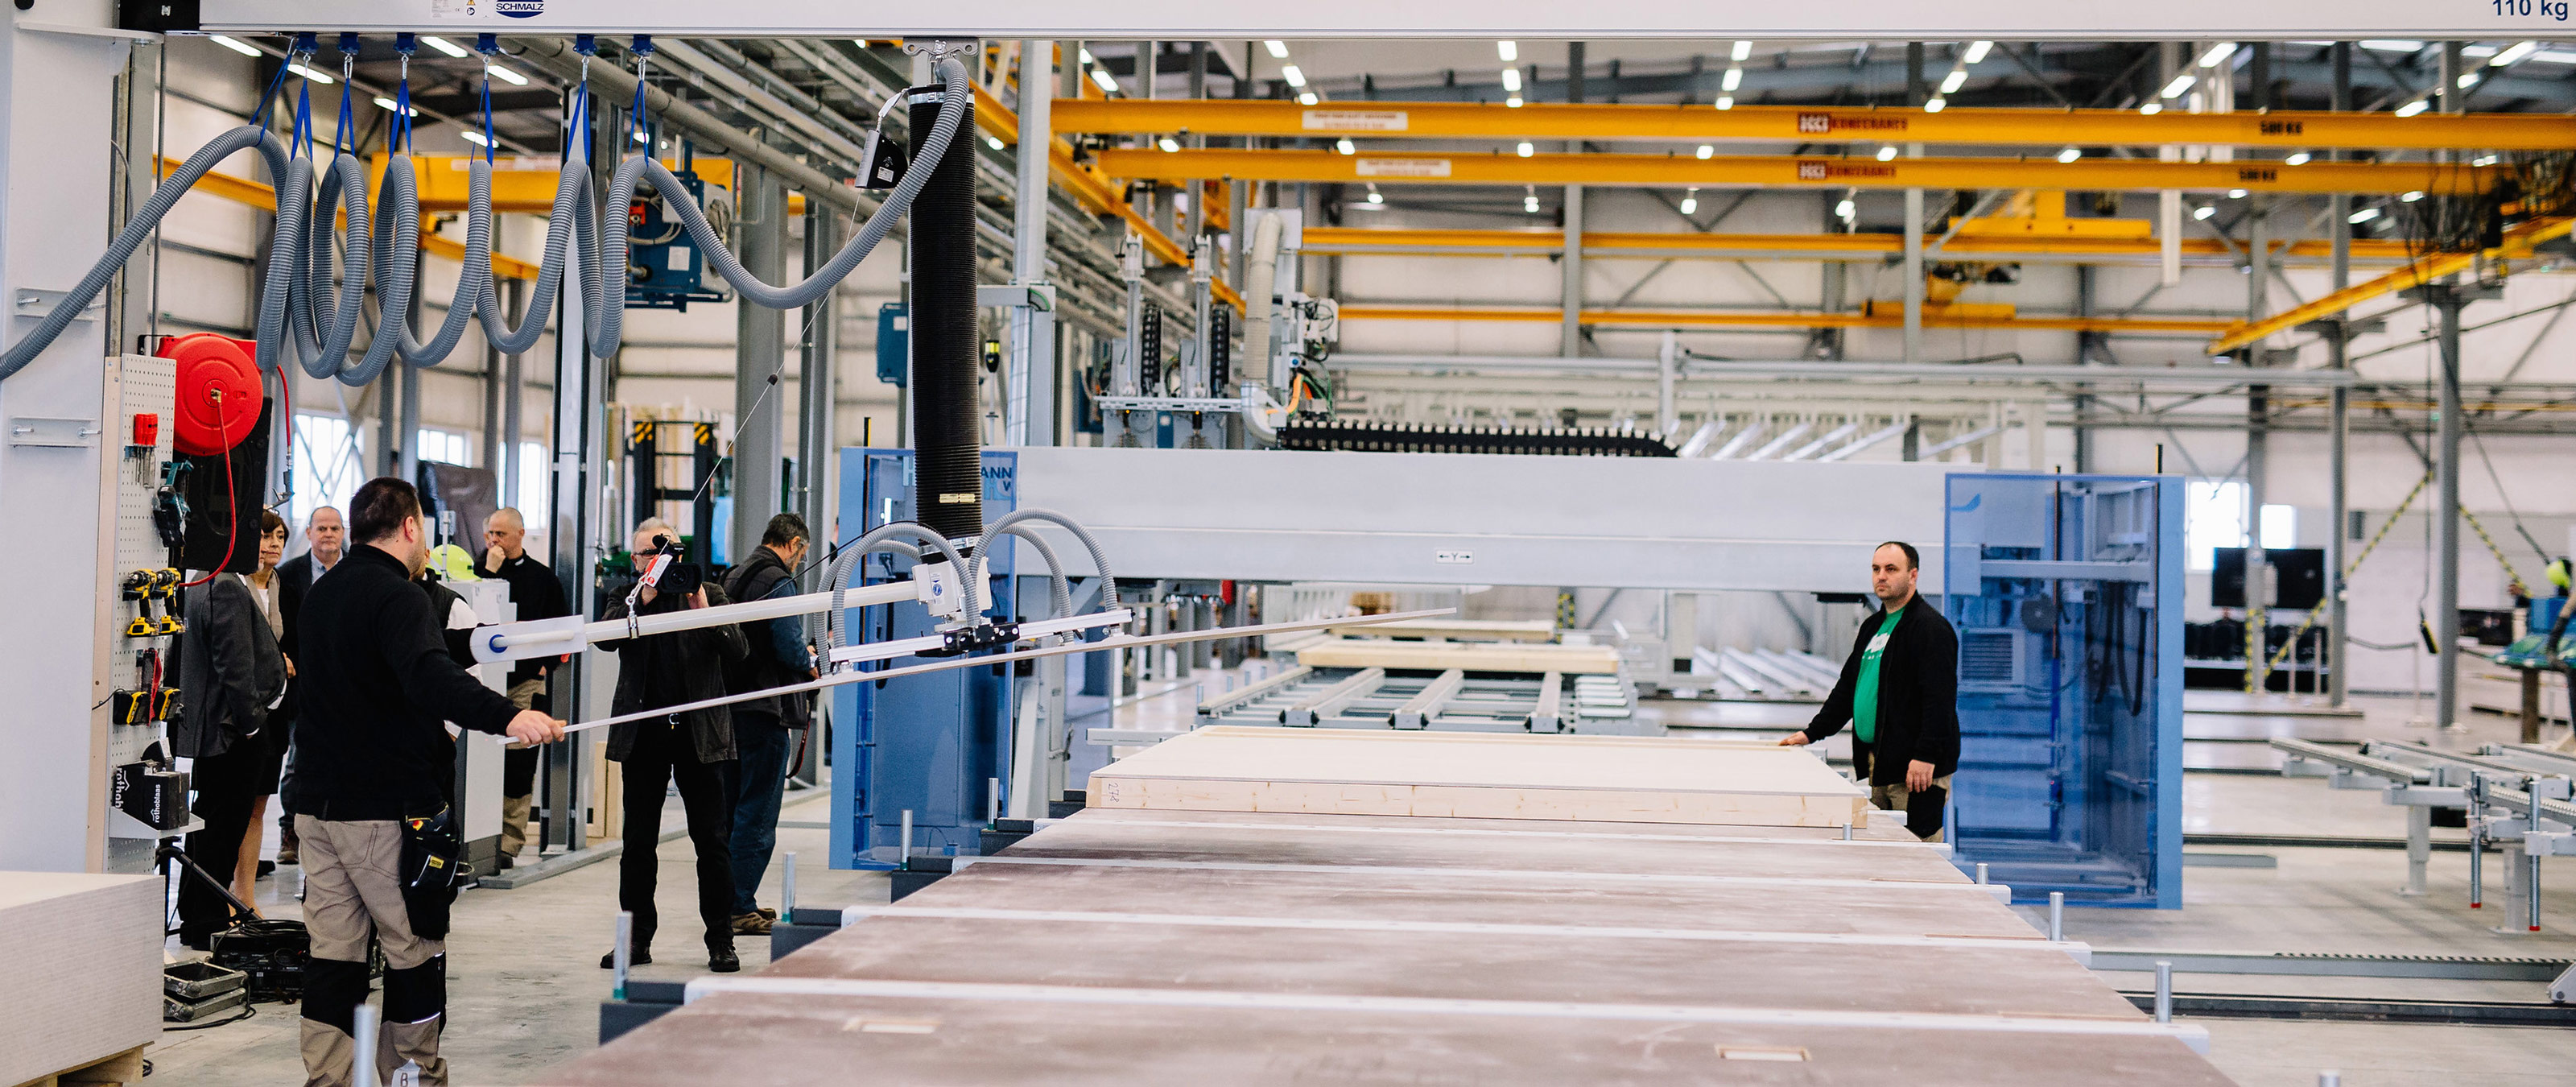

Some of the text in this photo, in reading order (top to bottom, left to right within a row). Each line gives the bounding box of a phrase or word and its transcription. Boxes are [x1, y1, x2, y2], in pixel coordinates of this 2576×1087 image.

[496, 2, 544, 10] SCHMALZ
[2492, 0, 2568, 21] 110 kg
[114, 767, 126, 811] rothob
[153, 783, 161, 823] rothoblaas
